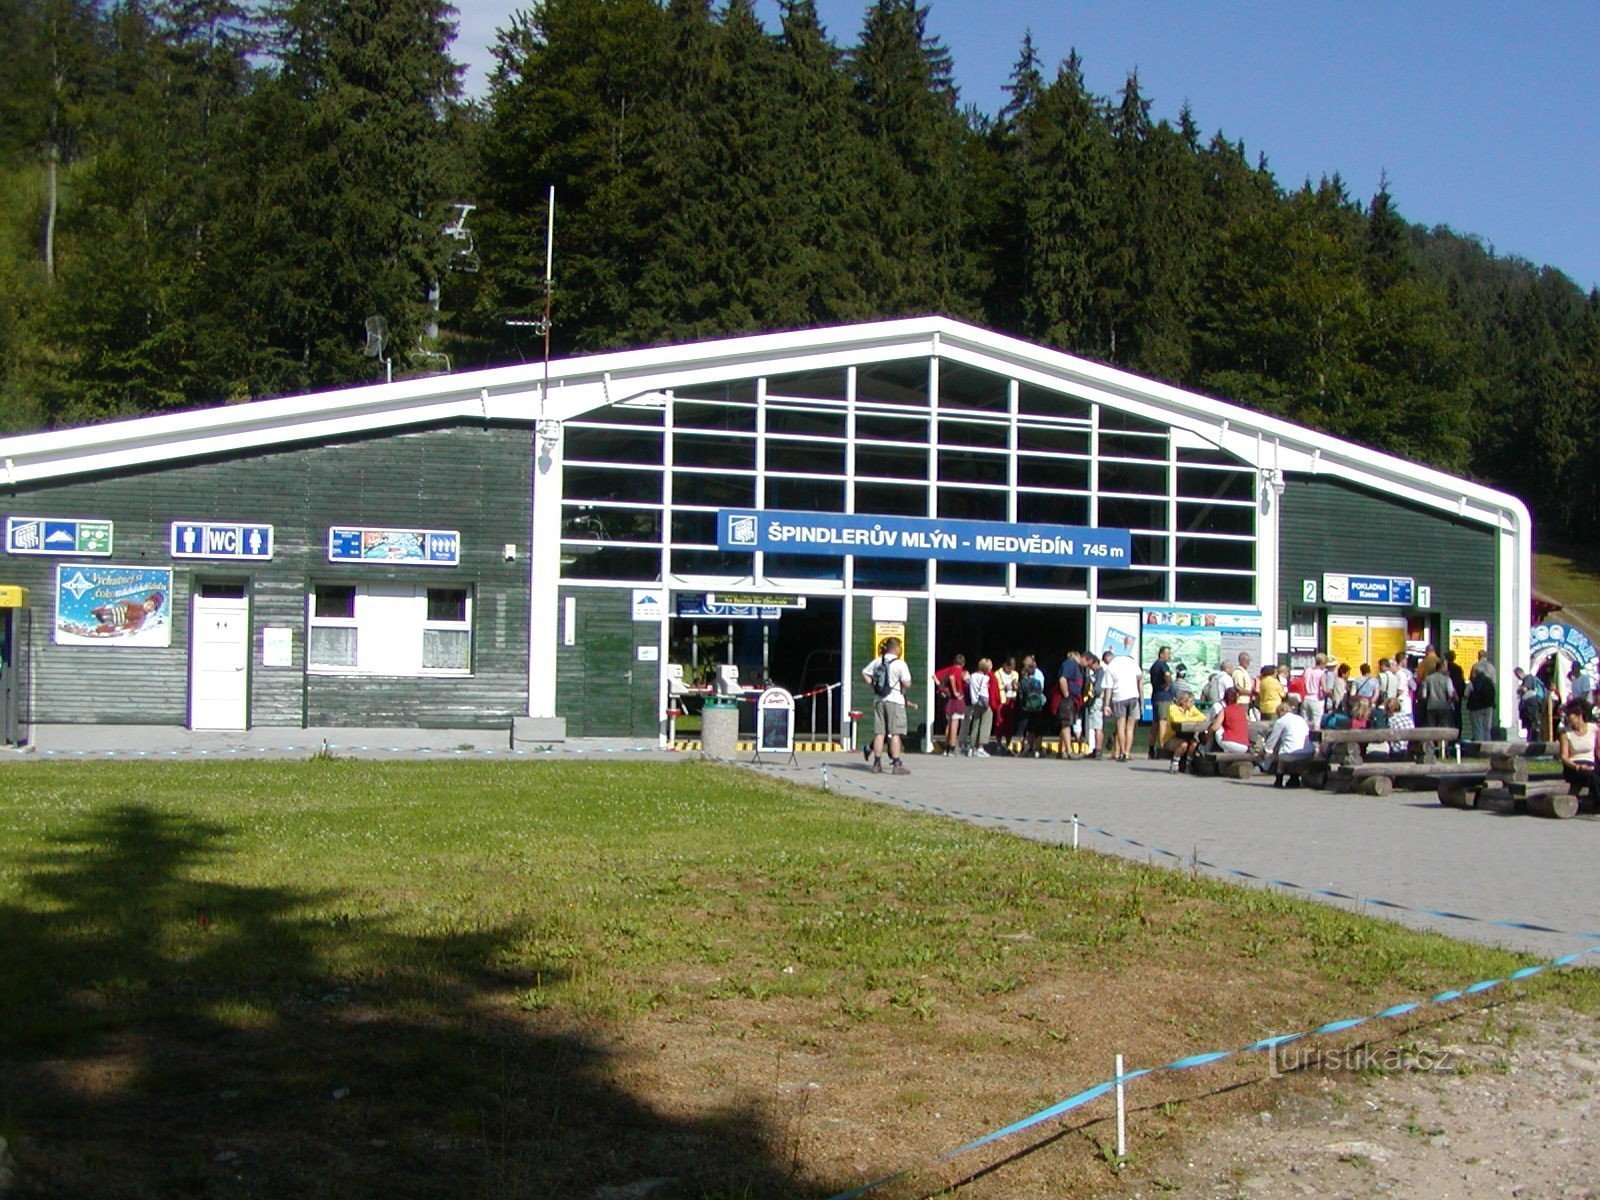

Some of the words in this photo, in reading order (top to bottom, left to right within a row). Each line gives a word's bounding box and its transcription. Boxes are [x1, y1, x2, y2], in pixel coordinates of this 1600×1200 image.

[209, 531, 236, 551] WC
[768, 521, 897, 546] ŠPINDLERŮV
[902, 529, 957, 549] MLÝN
[976, 534, 1073, 555] MEDVĚDÍN
[1082, 543, 1108, 557] 745
[1110, 549, 1124, 558] m
[1305, 582, 1316, 600] 2
[1351, 582, 1388, 592] POKLADNA
[1420, 588, 1428, 606] 1
